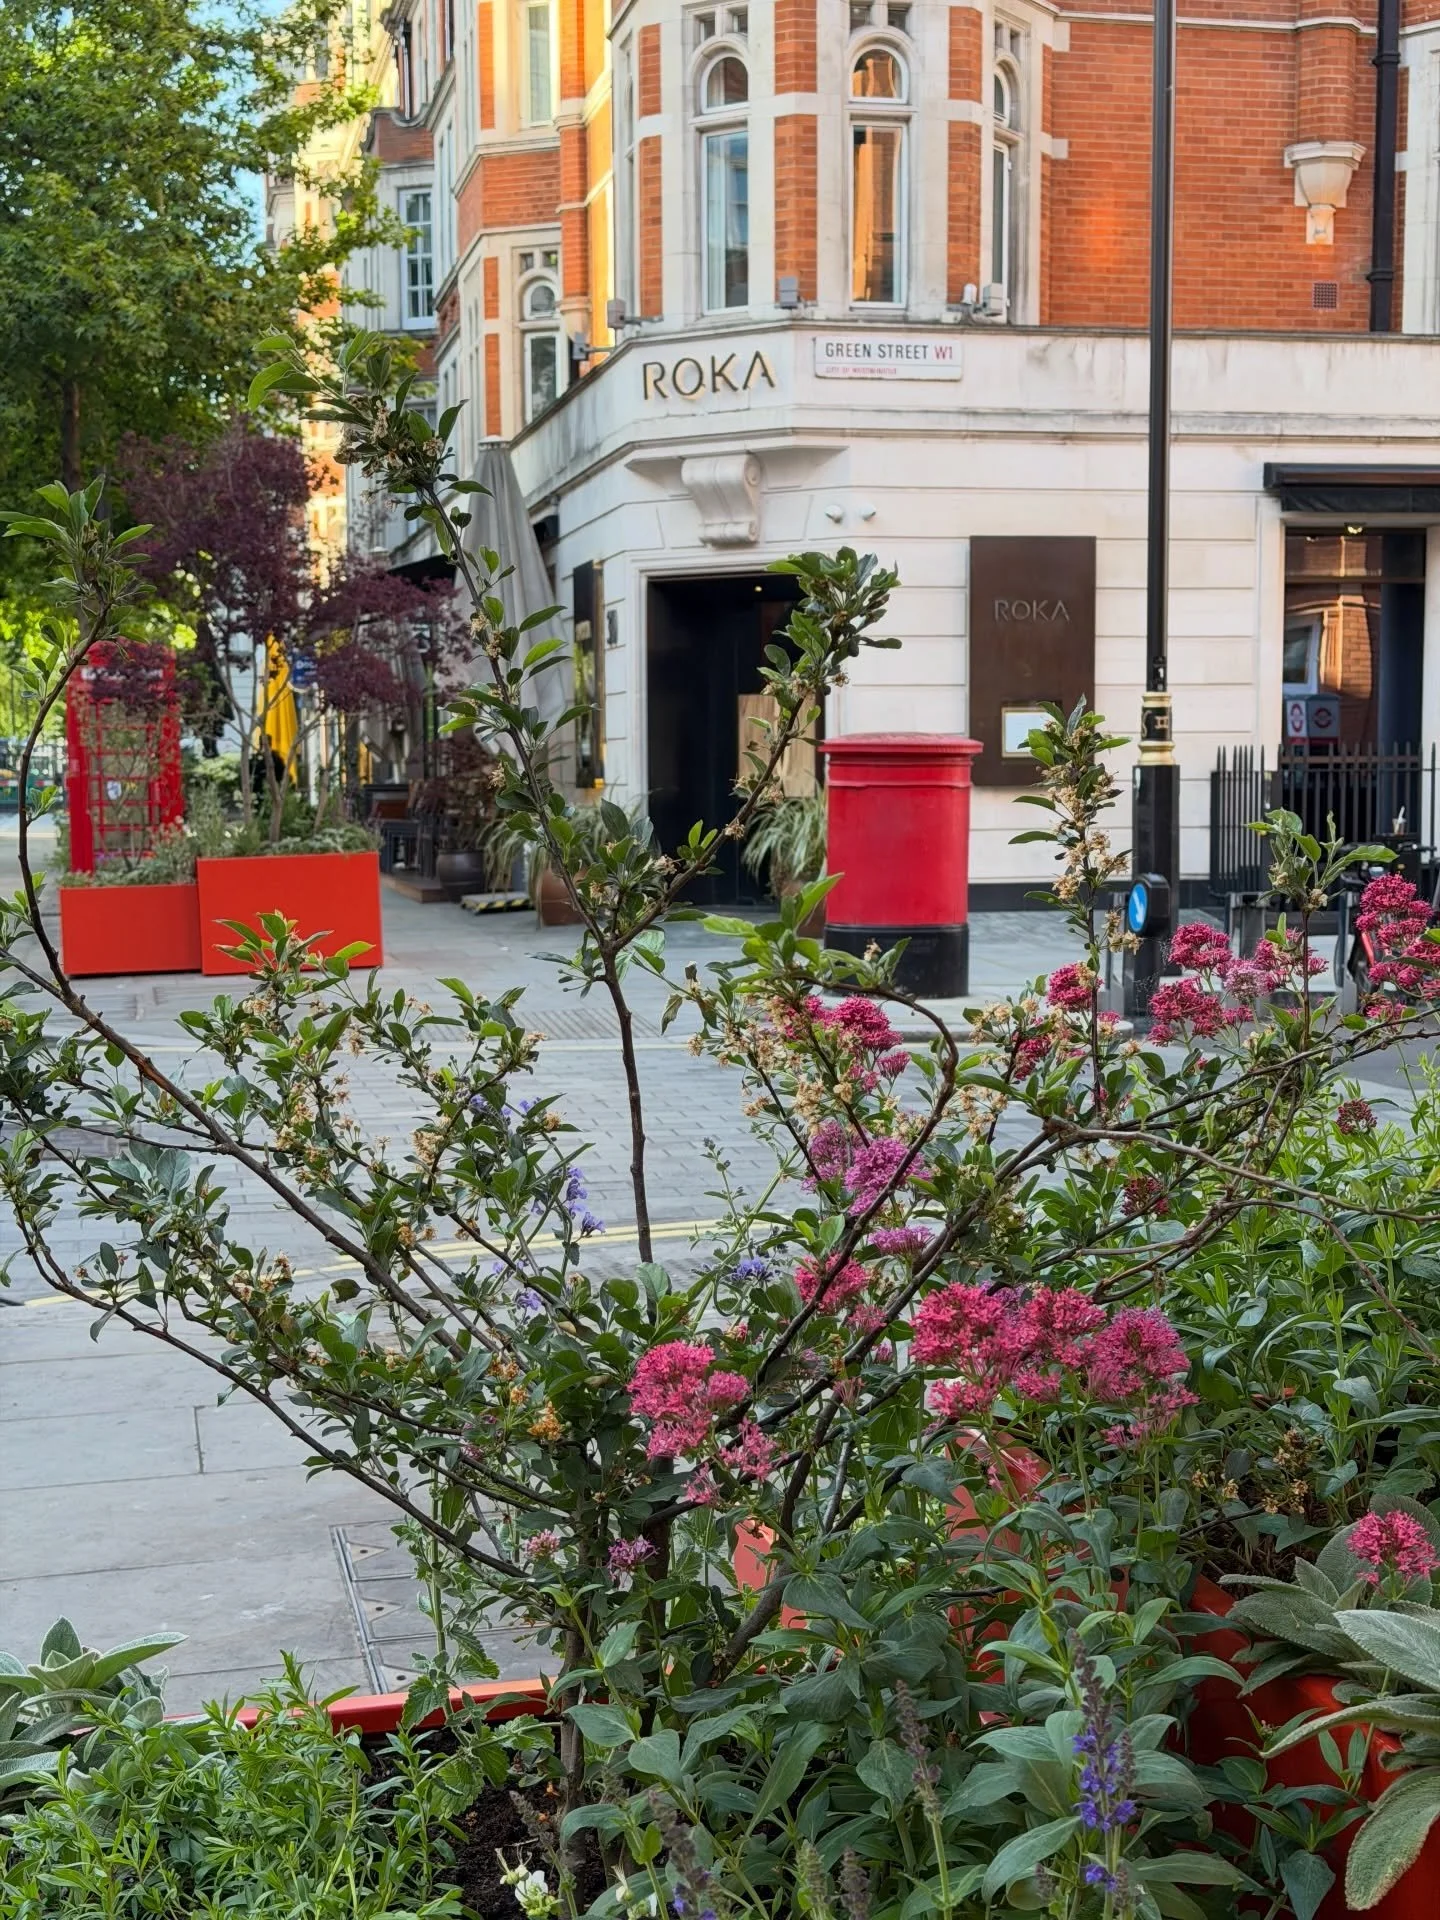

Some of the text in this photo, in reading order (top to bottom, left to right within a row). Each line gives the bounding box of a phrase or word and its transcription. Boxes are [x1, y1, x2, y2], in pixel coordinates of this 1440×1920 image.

[825, 342, 953, 360] GREEN STREET W1
[643, 350, 776, 400] ROKA
[994, 599, 1071, 622] ROKA
